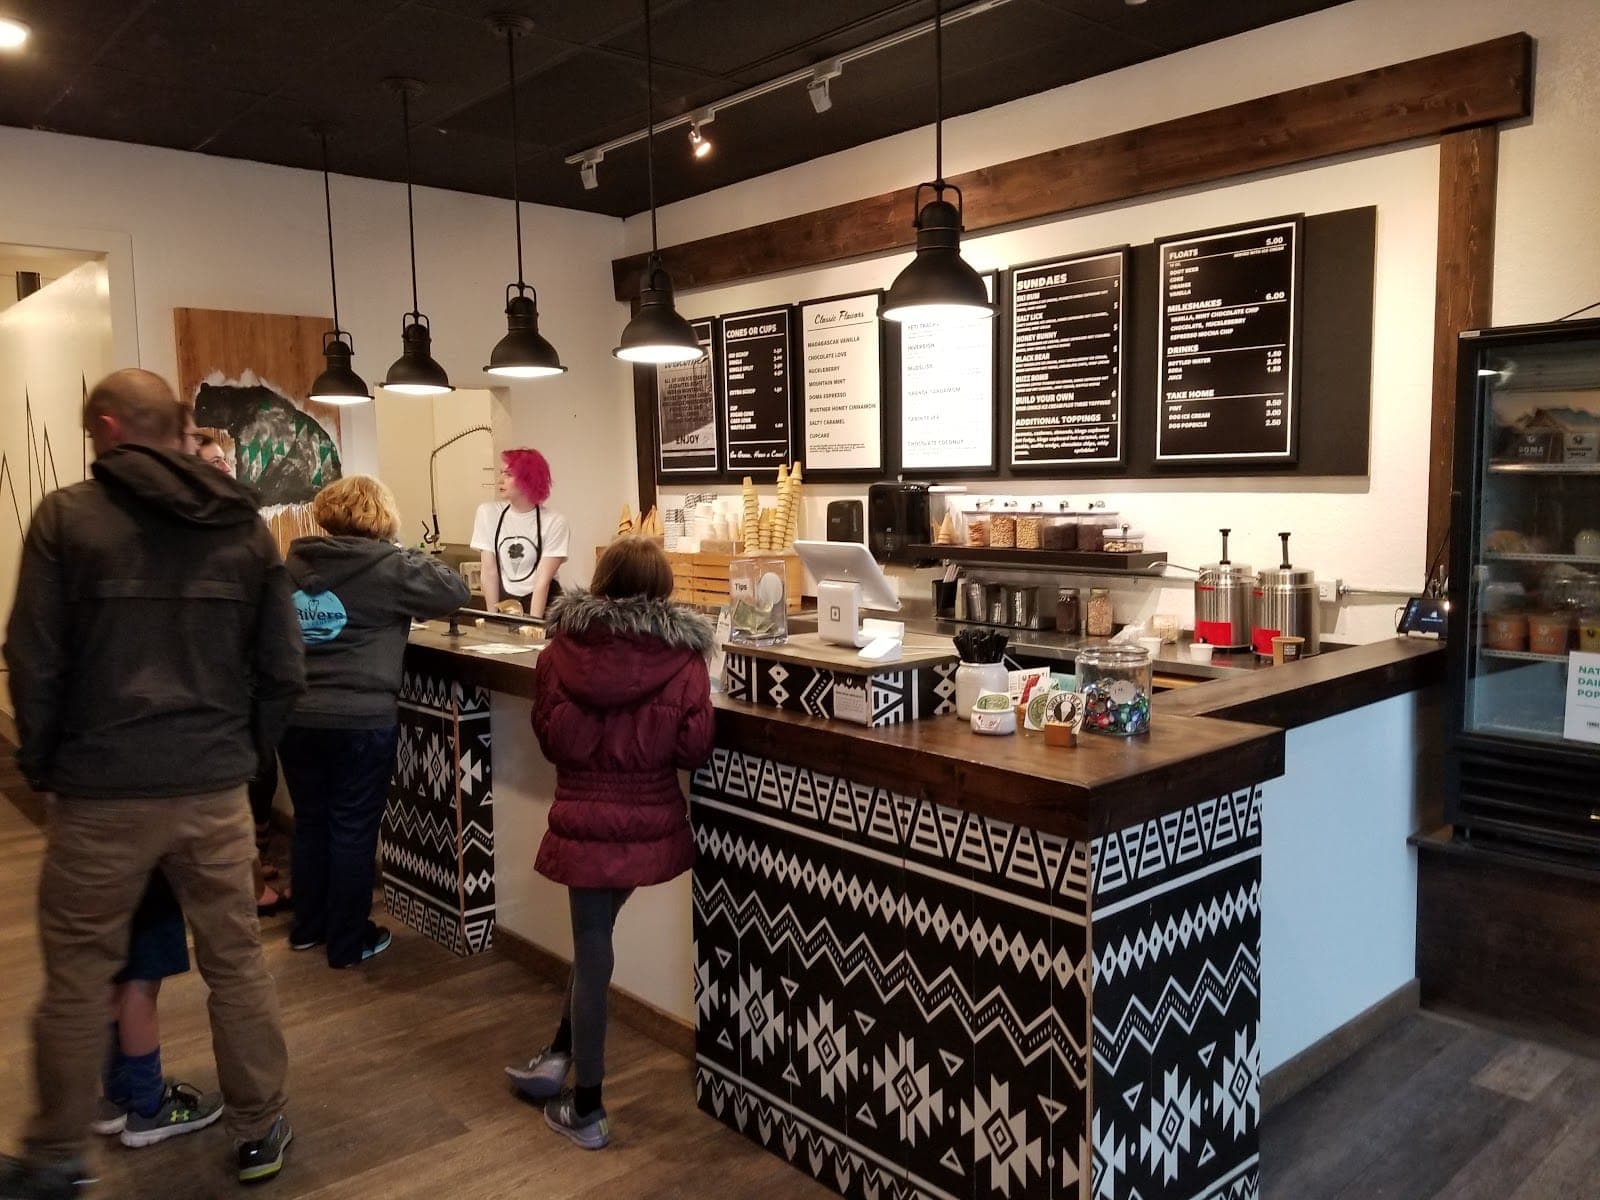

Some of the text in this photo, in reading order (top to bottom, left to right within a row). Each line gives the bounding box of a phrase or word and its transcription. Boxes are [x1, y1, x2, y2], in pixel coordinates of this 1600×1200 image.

[1265, 236, 1283, 245] 5.00
[1169, 248, 1198, 260] FLOATS
[1017, 274, 1067, 290] SUNDAES
[1265, 291, 1284, 300] 6.00
[1167, 298, 1222, 313] MILKSHAKES
[814, 310, 864, 324] Classic Flavors
[1210, 308, 1244, 318] CHOCOLATE
[1244, 306, 1260, 314] CHIP
[726, 324, 777, 339] CONES OR CUPS
[808, 336, 860, 348] MADAGASCAR VANILLA
[1167, 344, 1199, 355] DRINKS
[808, 352, 834, 360] CHOCOLATE
[808, 366, 840, 374] HUCKLEBERRY
[1016, 396, 1036, 404] BUILD
[1036, 394, 1056, 404] YOUR
[1056, 392, 1074, 402] OWN
[1166, 389, 1215, 400] TAKE HOME
[823, 418, 845, 426] CARAMEL
[1016, 416, 1060, 426] ADDITIONAL
[1061, 414, 1101, 424] TOPPINGS
[676, 434, 700, 445] ENJOY
[810, 432, 830, 440] CUPCAKE
[735, 583, 748, 592] Tips
